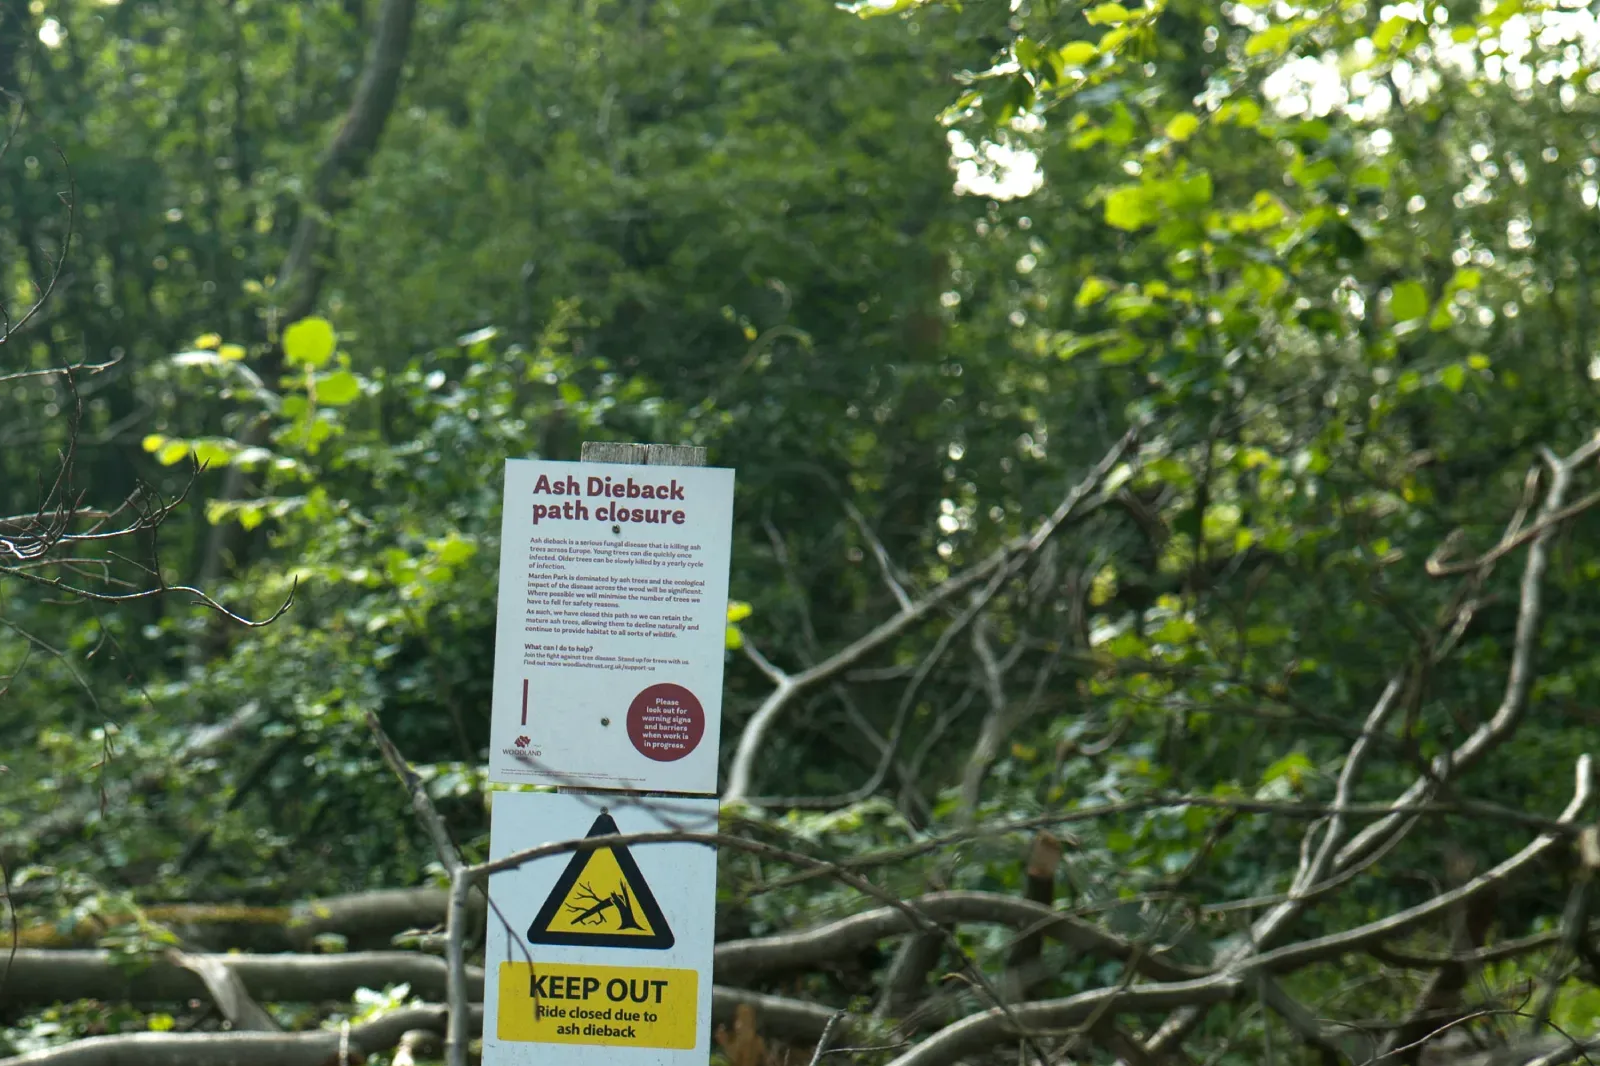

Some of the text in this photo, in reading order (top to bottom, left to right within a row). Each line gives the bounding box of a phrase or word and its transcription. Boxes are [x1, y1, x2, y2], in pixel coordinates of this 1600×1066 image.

[533, 474, 685, 501] Ash Dieback
[532, 499, 685, 525] path closure
[543, 537, 568, 545] dieback
[603, 540, 624, 548] fungal
[669, 543, 689, 552] killing
[568, 547, 592, 555] Europe.
[593, 548, 612, 556] Young
[653, 551, 676, 559] quickly
[529, 553, 556, 561] infected.
[614, 557, 634, 566] slowly
[653, 559, 661, 567] by
[666, 560, 686, 568] yearly
[687, 561, 704, 569] cycle
[536, 561, 566, 570] infection.
[553, 573, 568, 581] Park
[575, 574, 609, 582] dominated
[610, 576, 618, 584] by
[674, 579, 705, 588] ecological
[527, 589, 548, 597] Where
[668, 587, 703, 595] significant.
[526, 597, 542, 605] have
[572, 600, 593, 608] safety
[581, 619, 608, 627] allowing
[634, 621, 657, 629] decline
[657, 623, 686, 631] naturally
[524, 643, 542, 651] What
[576, 645, 593, 654] help?
[655, 698, 679, 706] Please
[642, 715, 691, 725] warning signs
[659, 723, 688, 732] barriers
[642, 731, 662, 739] when
[653, 742, 686, 750] progress.
[502, 749, 542, 757] WOODLAND
[529, 974, 668, 1004] KEEP OUT
[536, 1005, 658, 1022] Ride closed due to
[556, 1023, 636, 1038] ash dieback
